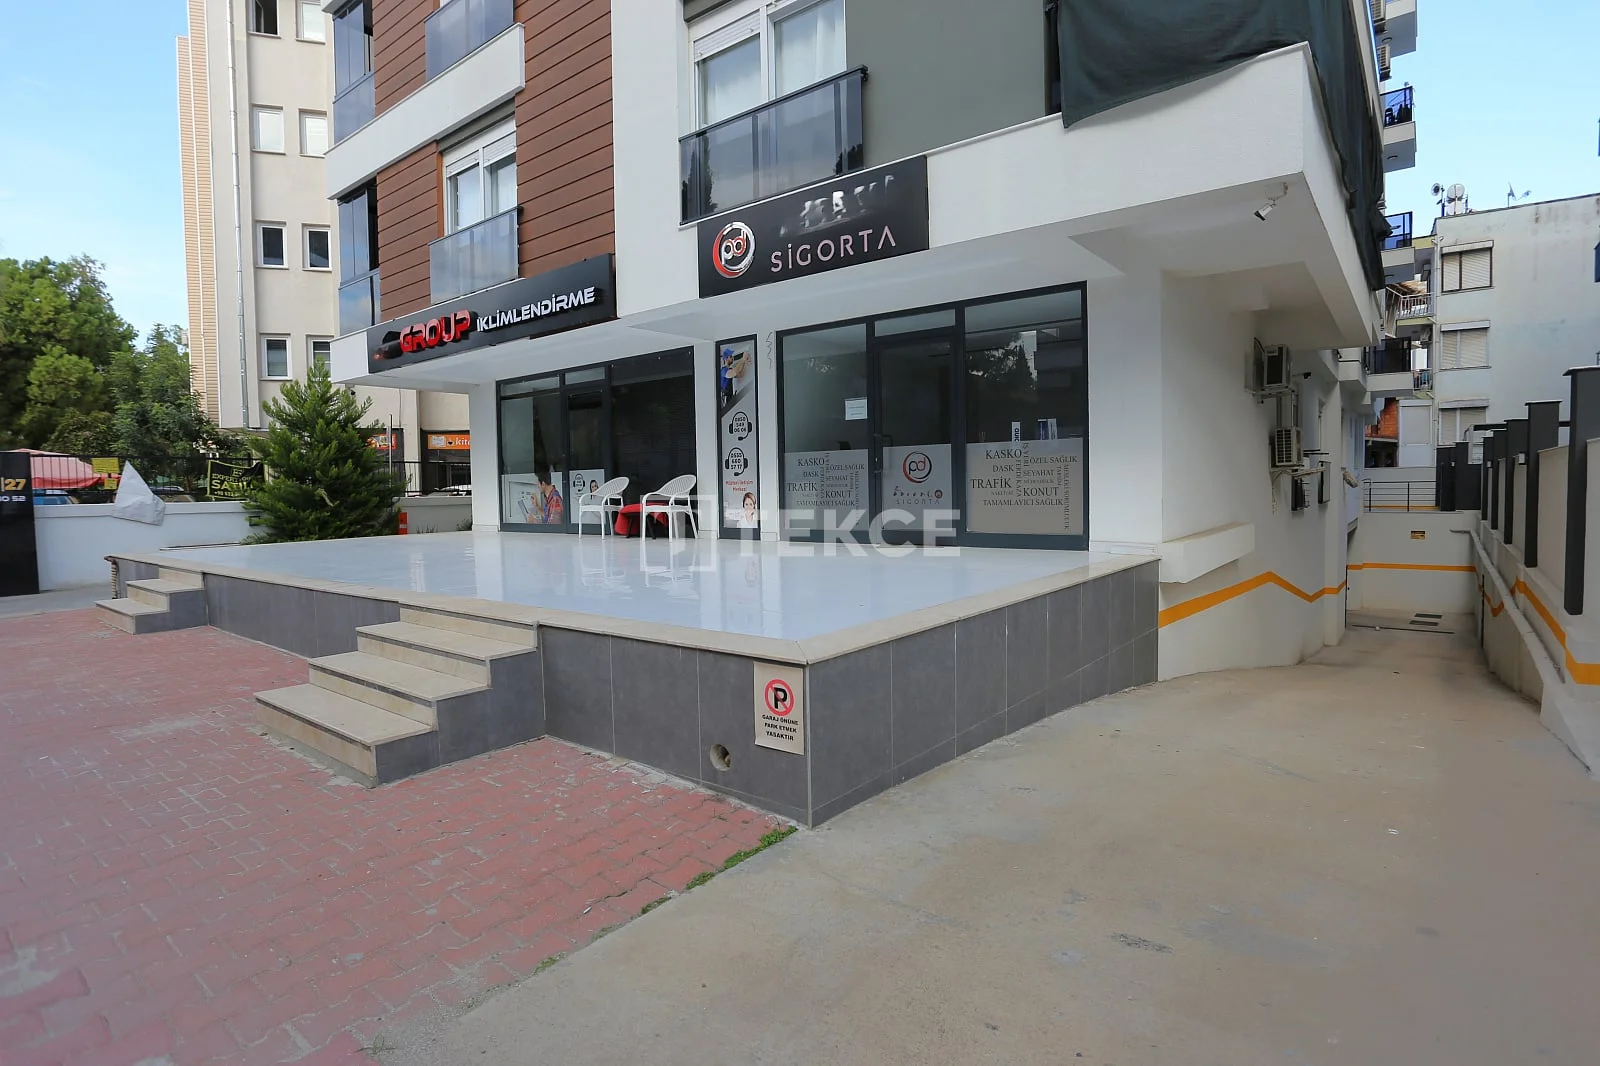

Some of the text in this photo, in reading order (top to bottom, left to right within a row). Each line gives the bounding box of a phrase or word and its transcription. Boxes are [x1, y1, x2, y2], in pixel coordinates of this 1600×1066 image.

[400, 309, 471, 352] GROUP
[985, 448, 1022, 460] KASKO
[1029, 454, 1078, 464] ÖZEL SAĞLIK
[798, 457, 825, 467] KASKO
[992, 464, 1014, 472] DASK
[1023, 469, 1054, 477] SEYAHAT
[803, 470, 819, 478] DASK
[5, 478, 26, 490] 27
[787, 481, 818, 492] TRAFİK
[971, 476, 1012, 489] TRAFİK
[825, 490, 852, 499] KONUT
[1023, 487, 1059, 497] KONUT
[1035, 498, 1064, 507] SAĞLIK
[762, 714, 779, 722] GARAJ
[764, 722, 797, 734] PARK ETMEK
[766, 730, 794, 742] YASAKTIR
